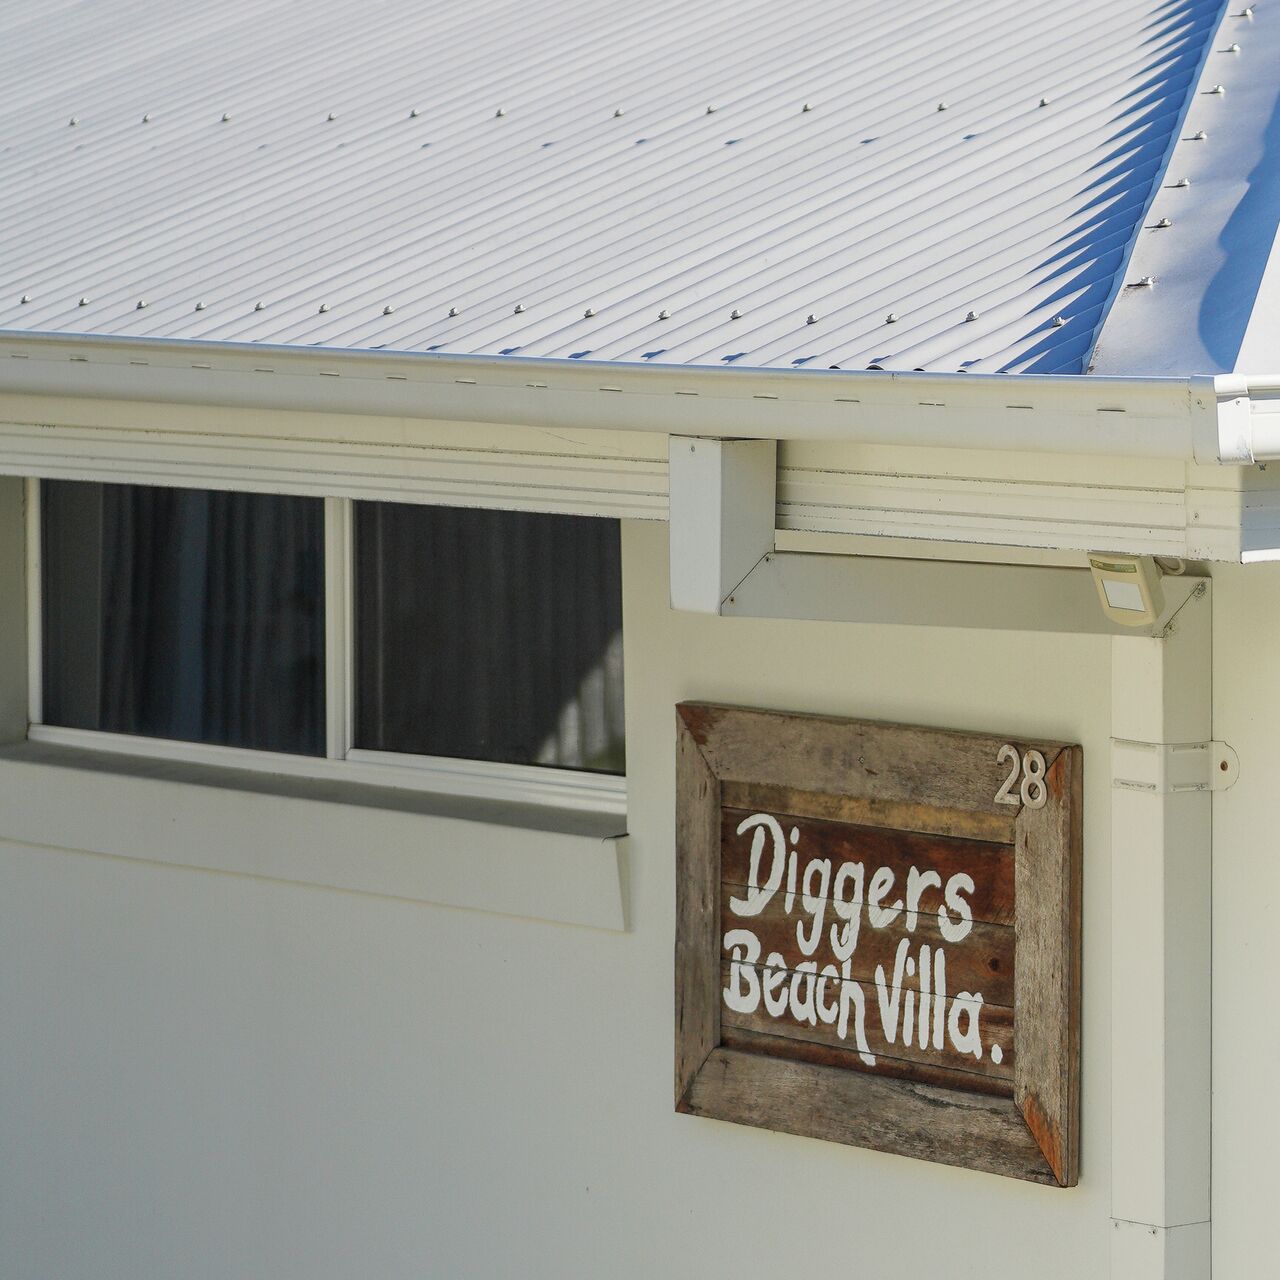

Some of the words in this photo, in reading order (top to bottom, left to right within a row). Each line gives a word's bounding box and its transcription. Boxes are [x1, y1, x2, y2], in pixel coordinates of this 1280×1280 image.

[995, 745, 1048, 810] 28
[729, 814, 975, 961] Diggers
[723, 929, 876, 1066] Beach
